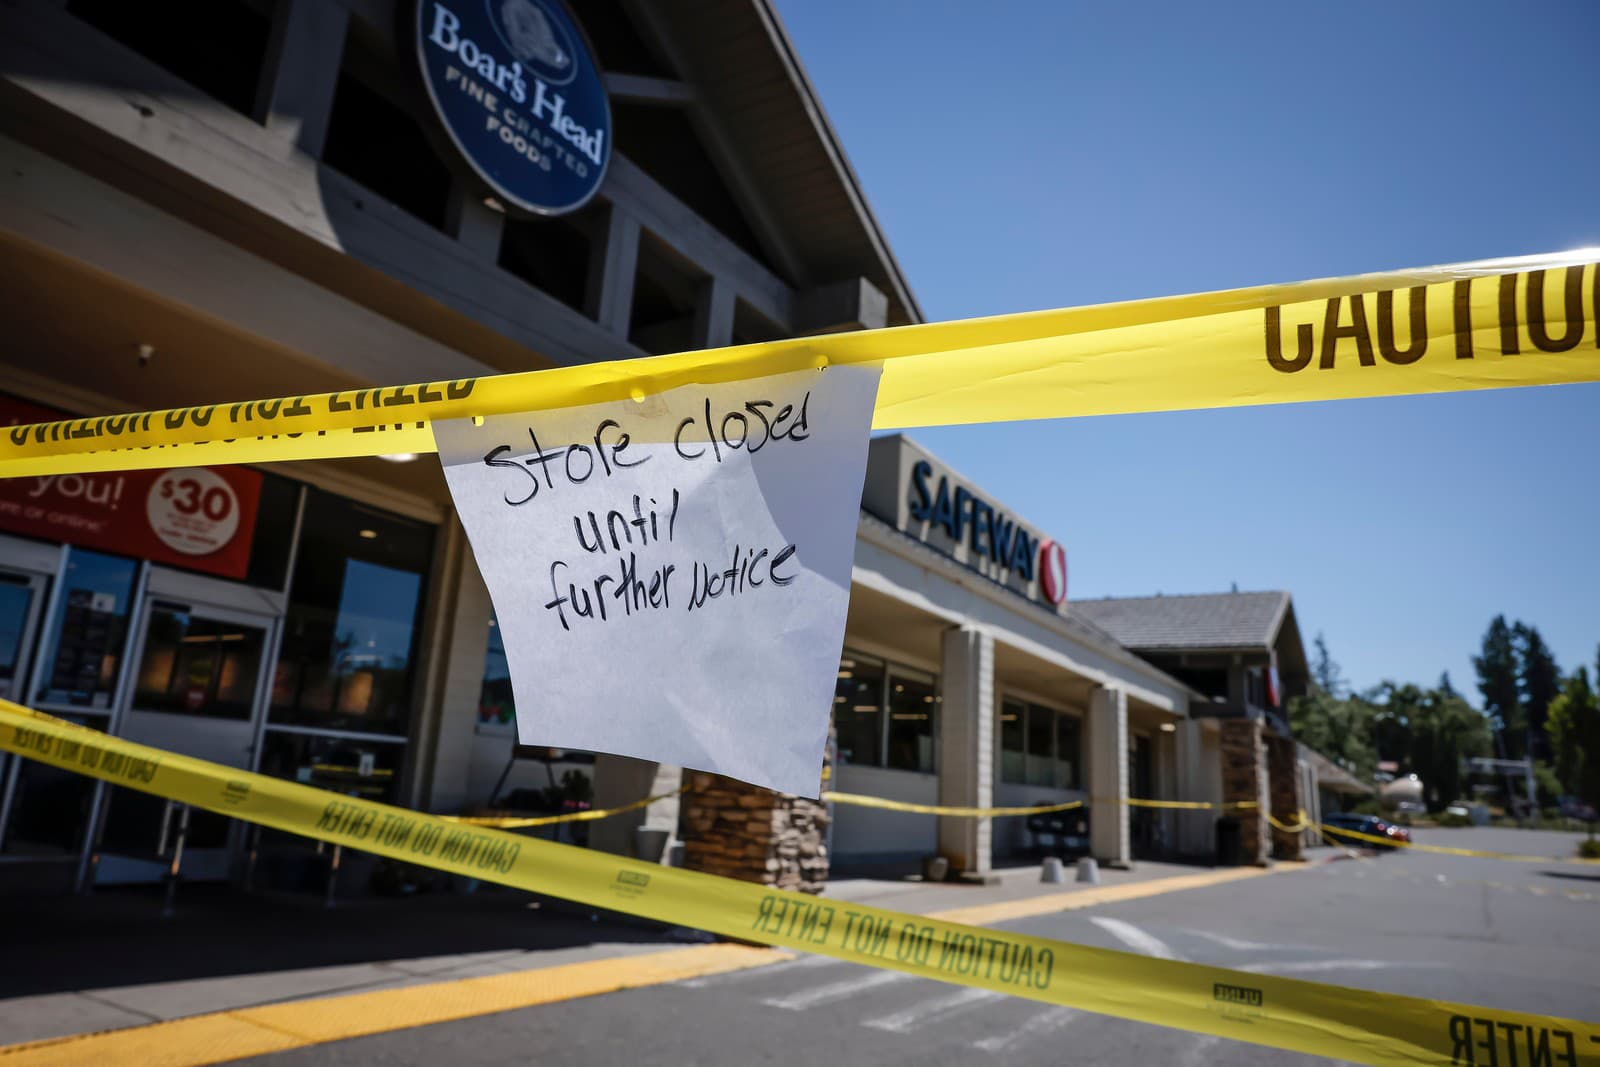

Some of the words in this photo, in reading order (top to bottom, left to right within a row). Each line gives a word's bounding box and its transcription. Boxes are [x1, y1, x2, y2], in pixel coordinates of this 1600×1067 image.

[430, 3, 526, 103] Boar's
[532, 79, 604, 165] Head
[446, 65, 498, 112] FINE
[503, 108, 588, 178] CRAFTED
[486, 115, 551, 171] FOODS
[674, 391, 810, 463] closed
[161, 478, 233, 522] $30
[573, 488, 679, 555] until
[910, 460, 1039, 582] SAFEWAY
[544, 552, 675, 631] further
